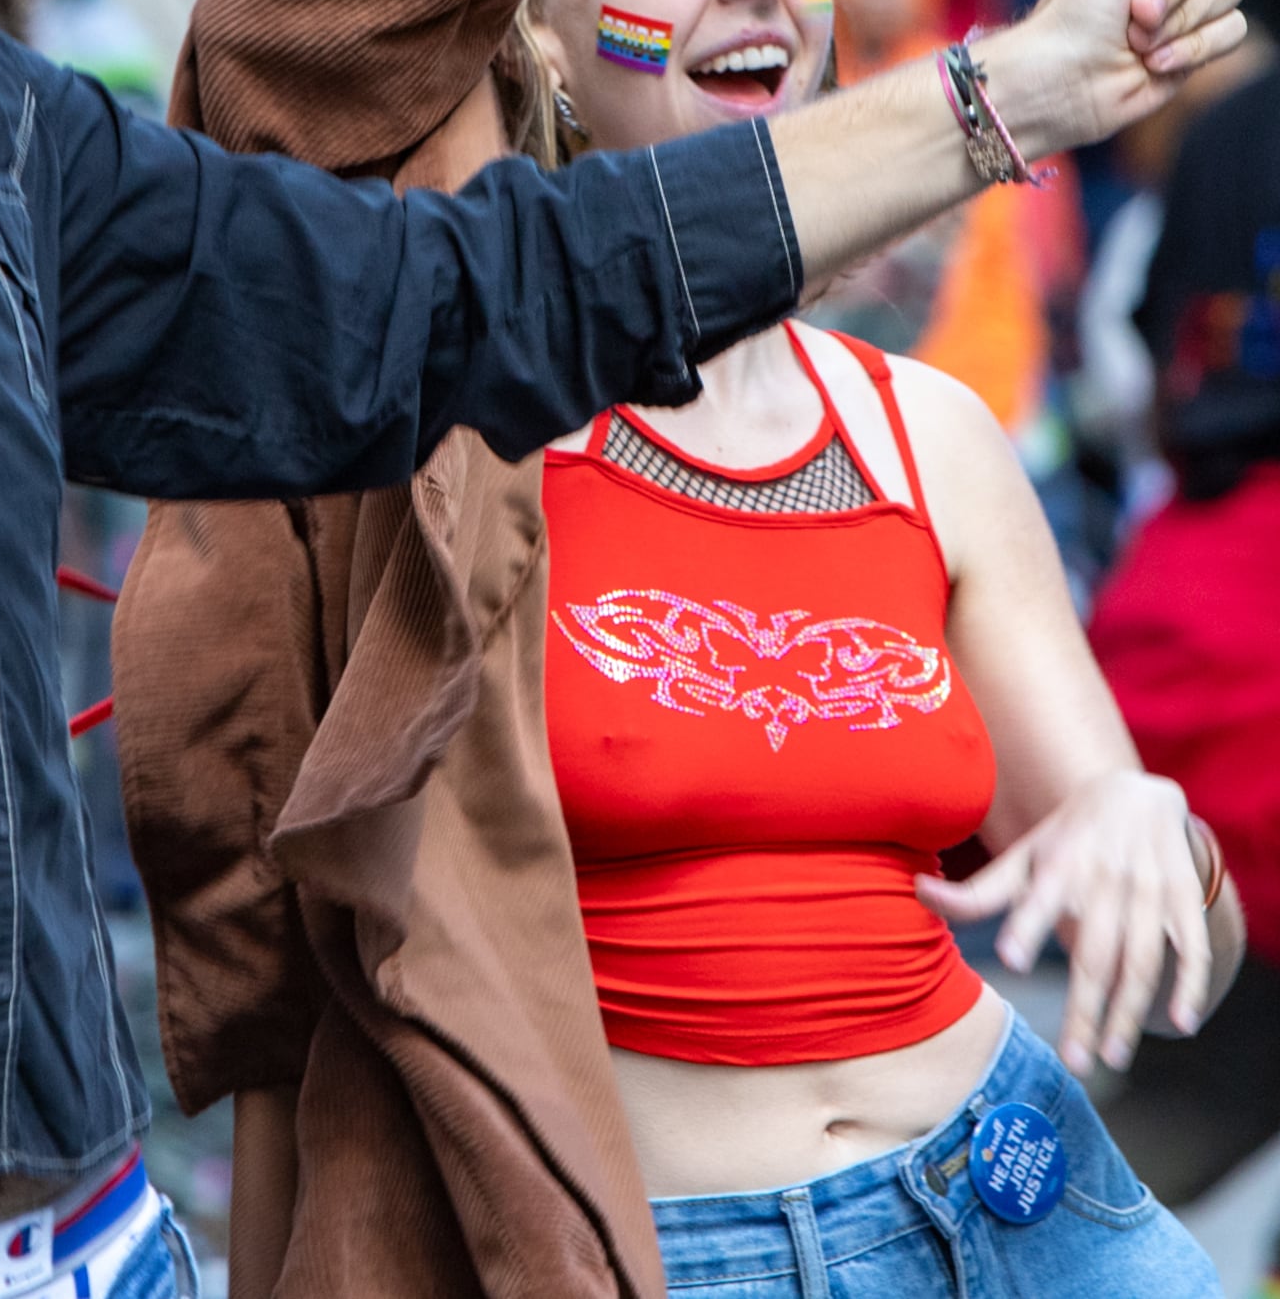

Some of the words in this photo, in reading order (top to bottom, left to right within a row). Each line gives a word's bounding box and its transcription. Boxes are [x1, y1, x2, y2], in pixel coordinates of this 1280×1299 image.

[601, 14, 667, 63] PRIDE
[988, 1117, 1030, 1192] HEALTH.
[1009, 1139, 1040, 1191] JOBS.
[1017, 1136, 1059, 1215] JUSTICE.
